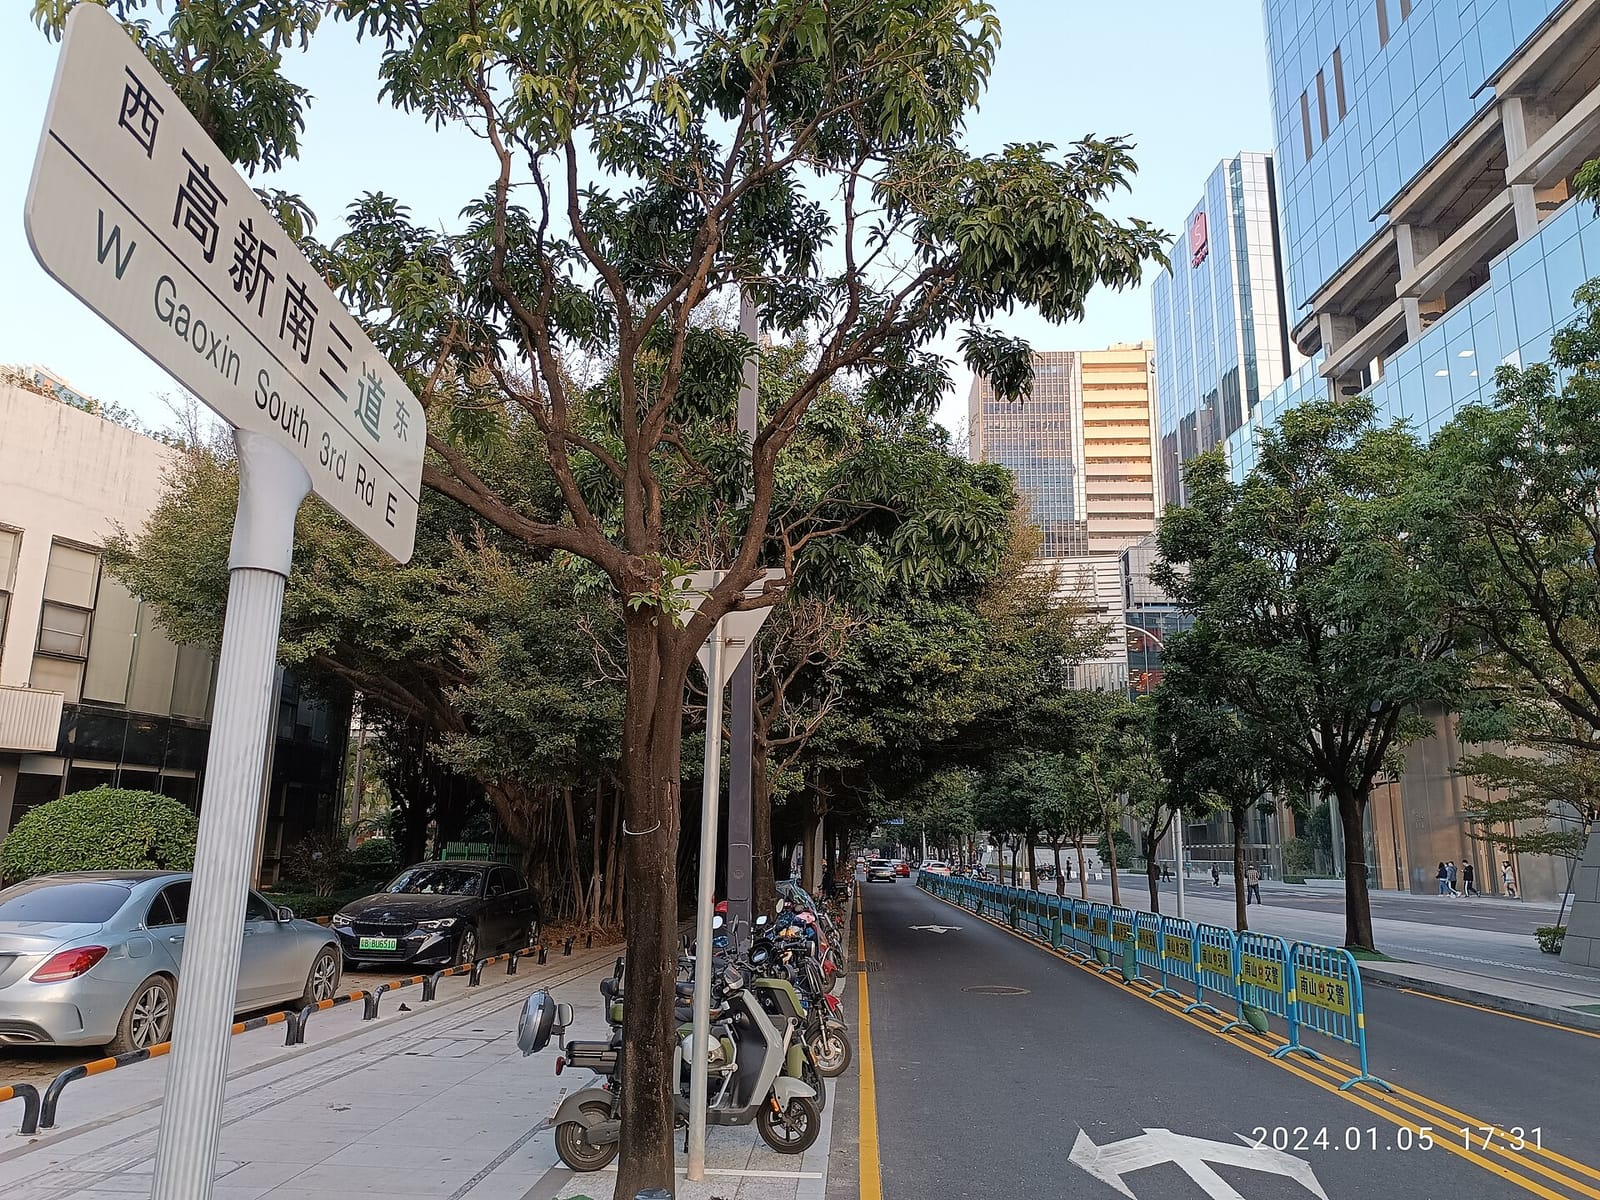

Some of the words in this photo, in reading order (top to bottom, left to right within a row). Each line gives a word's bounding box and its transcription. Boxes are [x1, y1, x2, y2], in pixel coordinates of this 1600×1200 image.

[96, 208, 137, 281] W
[153, 275, 241, 386] Gaoxin
[254, 368, 310, 447] South
[319, 432, 346, 483] 3rd
[356, 463, 375, 509] Rd
[385, 491, 398, 529] E
[118, 64, 165, 158] 西
[172, 147, 387, 443] 高新南三道
[393, 399, 411, 443] 东
